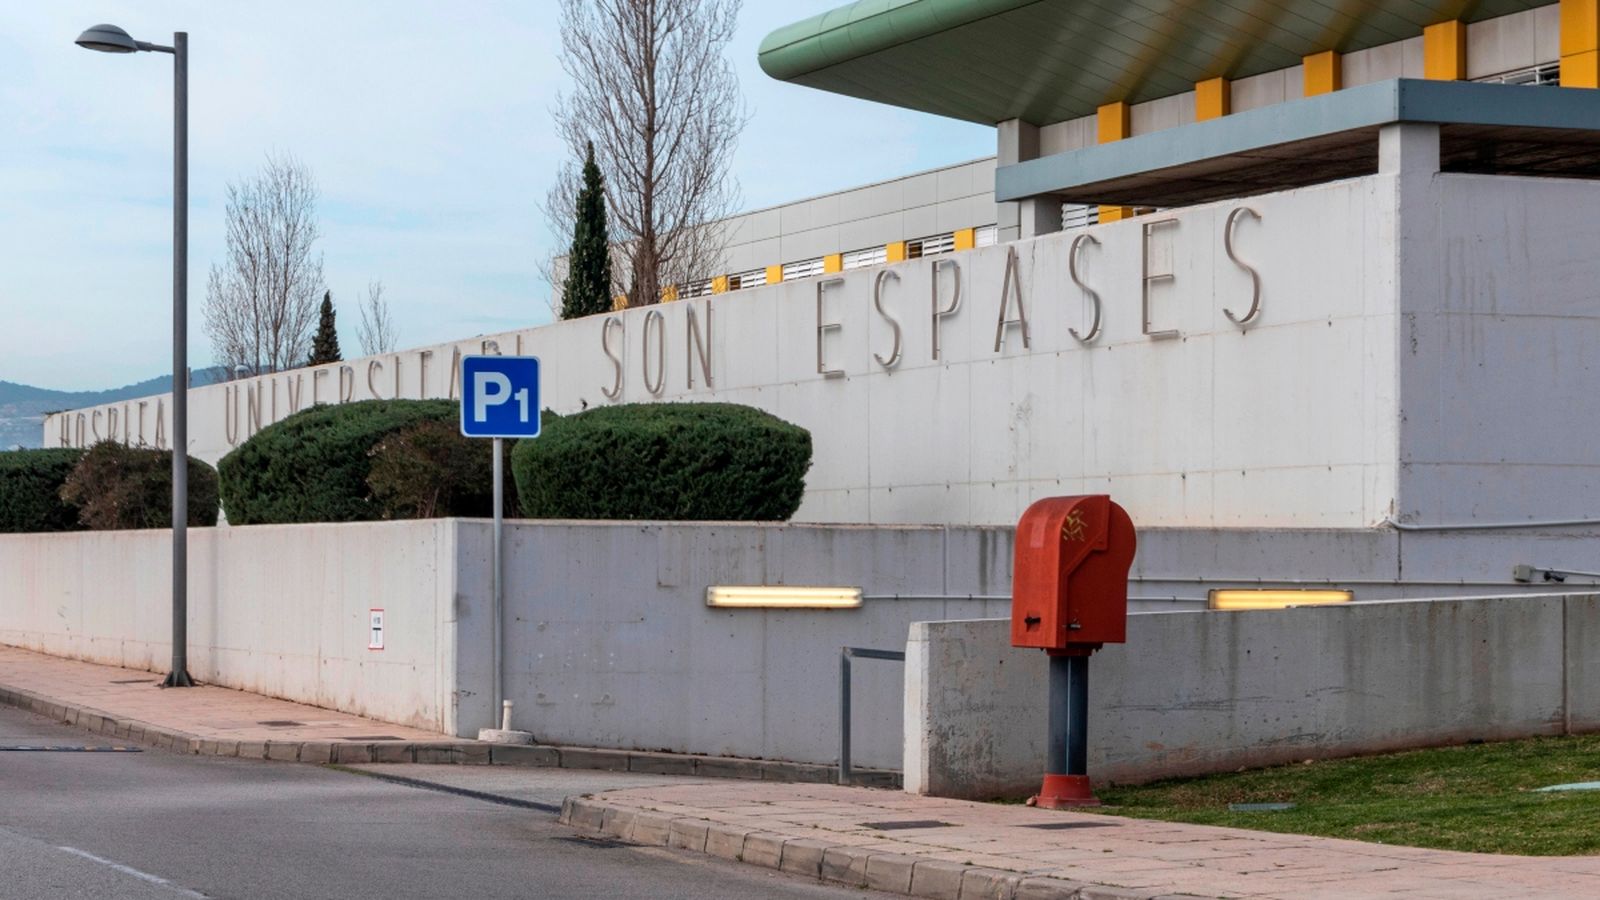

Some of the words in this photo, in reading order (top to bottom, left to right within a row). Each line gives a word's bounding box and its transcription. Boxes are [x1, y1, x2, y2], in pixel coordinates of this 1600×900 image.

[60, 398, 170, 449] HOSPITA
[601, 299, 715, 399] SON
[816, 206, 1263, 378] ESPASES
[474, 371, 529, 423] P1
